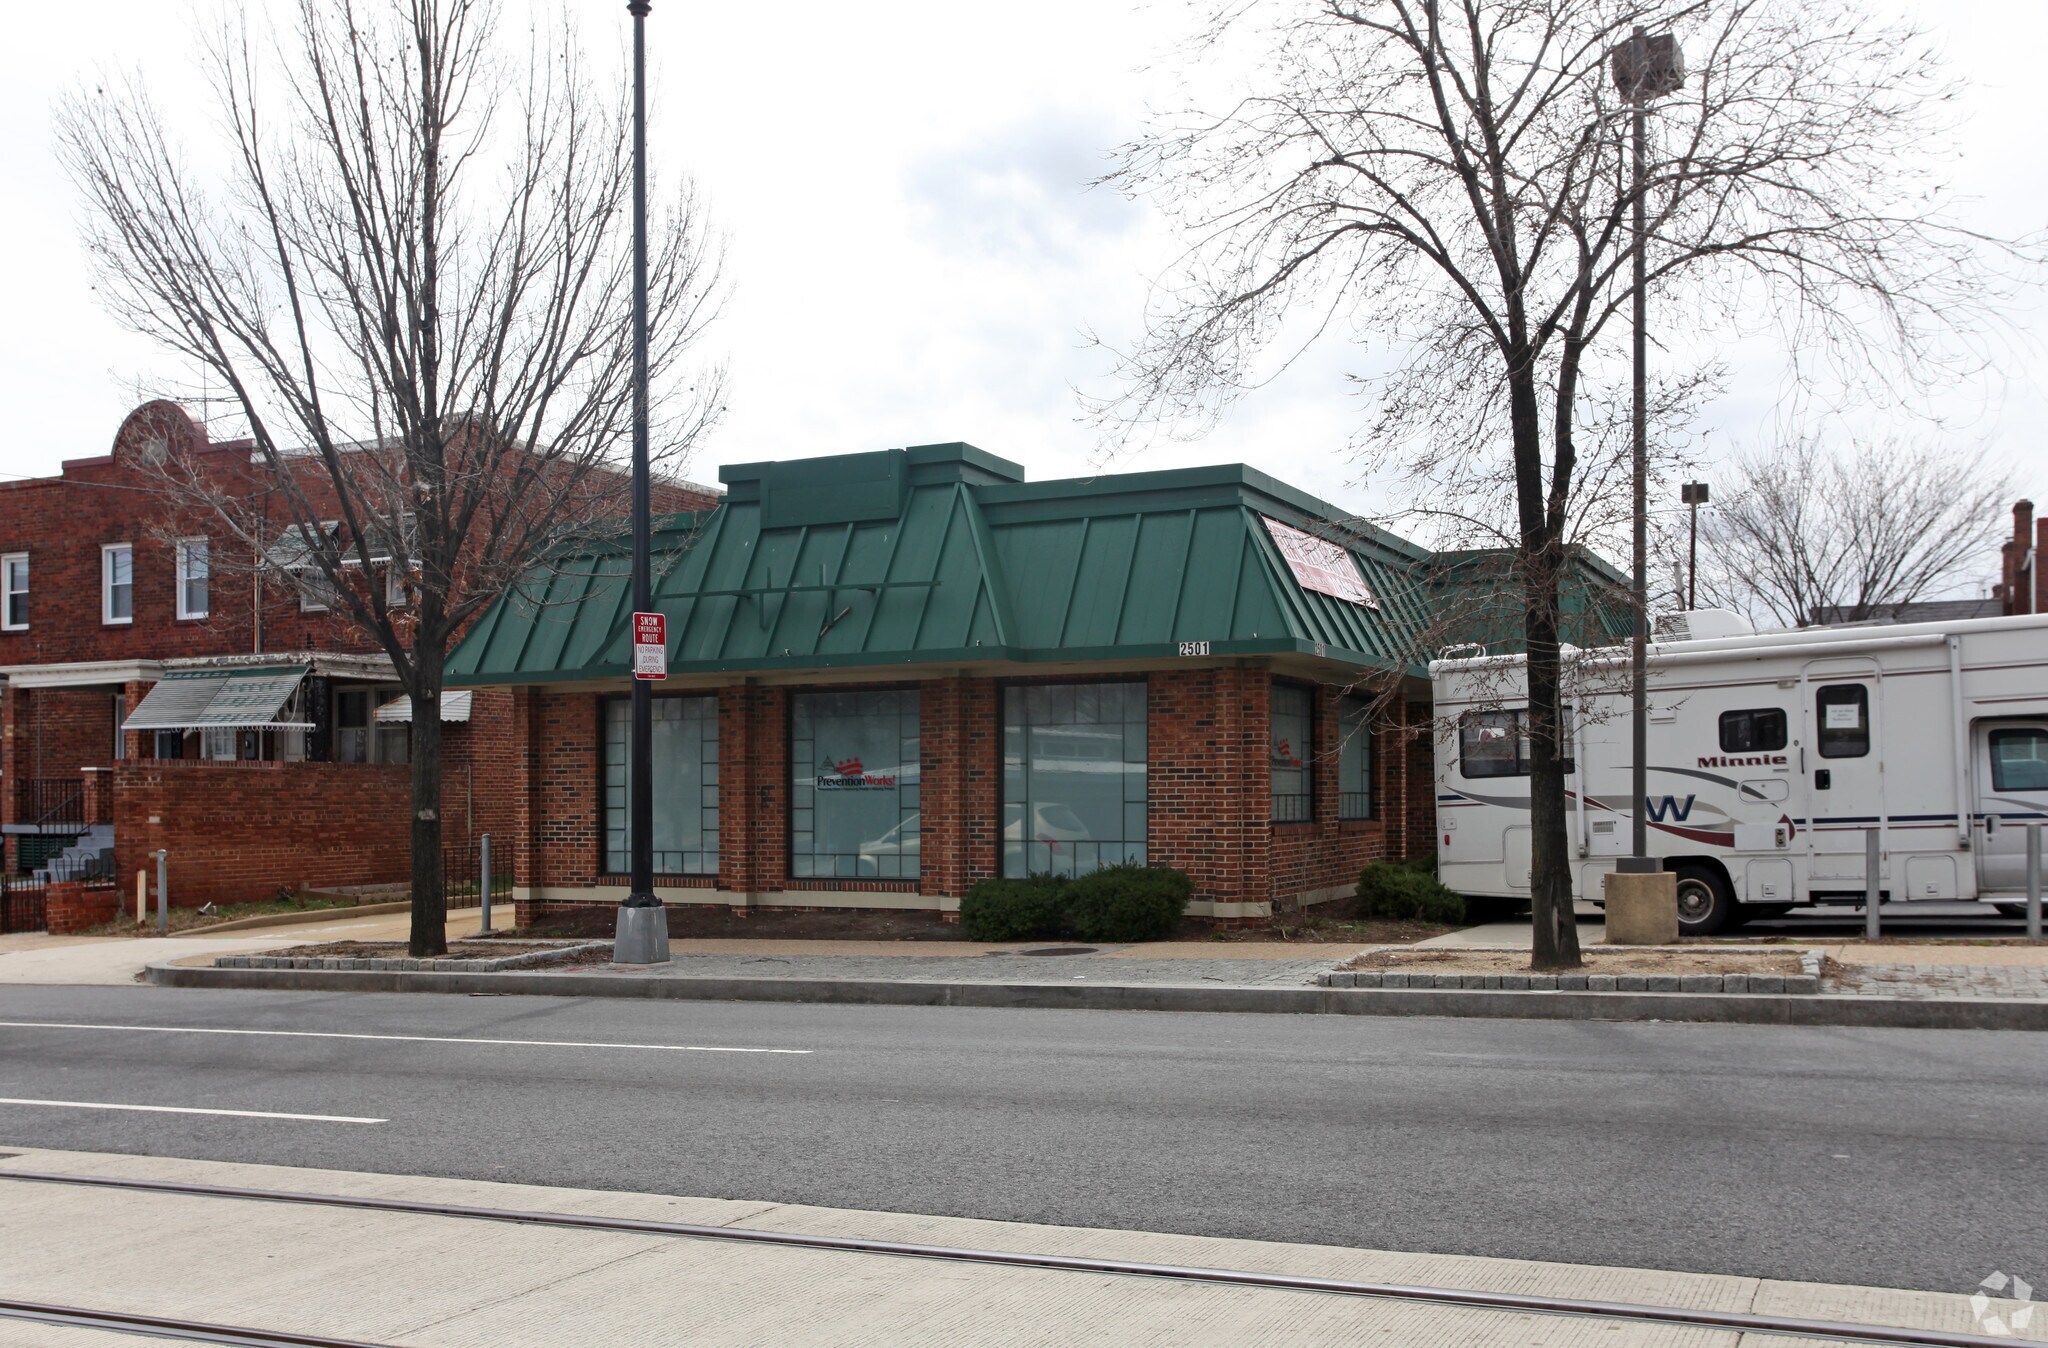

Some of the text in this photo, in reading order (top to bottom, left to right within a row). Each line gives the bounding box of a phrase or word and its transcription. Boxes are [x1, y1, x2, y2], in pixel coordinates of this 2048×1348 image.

[640, 616, 658, 626] SNOW
[641, 633, 659, 643] ROUTE
[638, 645, 664, 655] NO PARKING
[1181, 642, 1208, 655] 2501
[642, 655, 659, 663] DURING
[638, 664, 663, 673] EMERGENCY
[1697, 754, 1787, 768] Minnie
[817, 775, 896, 786] PreventionWorks!
[1646, 794, 1696, 822] W
